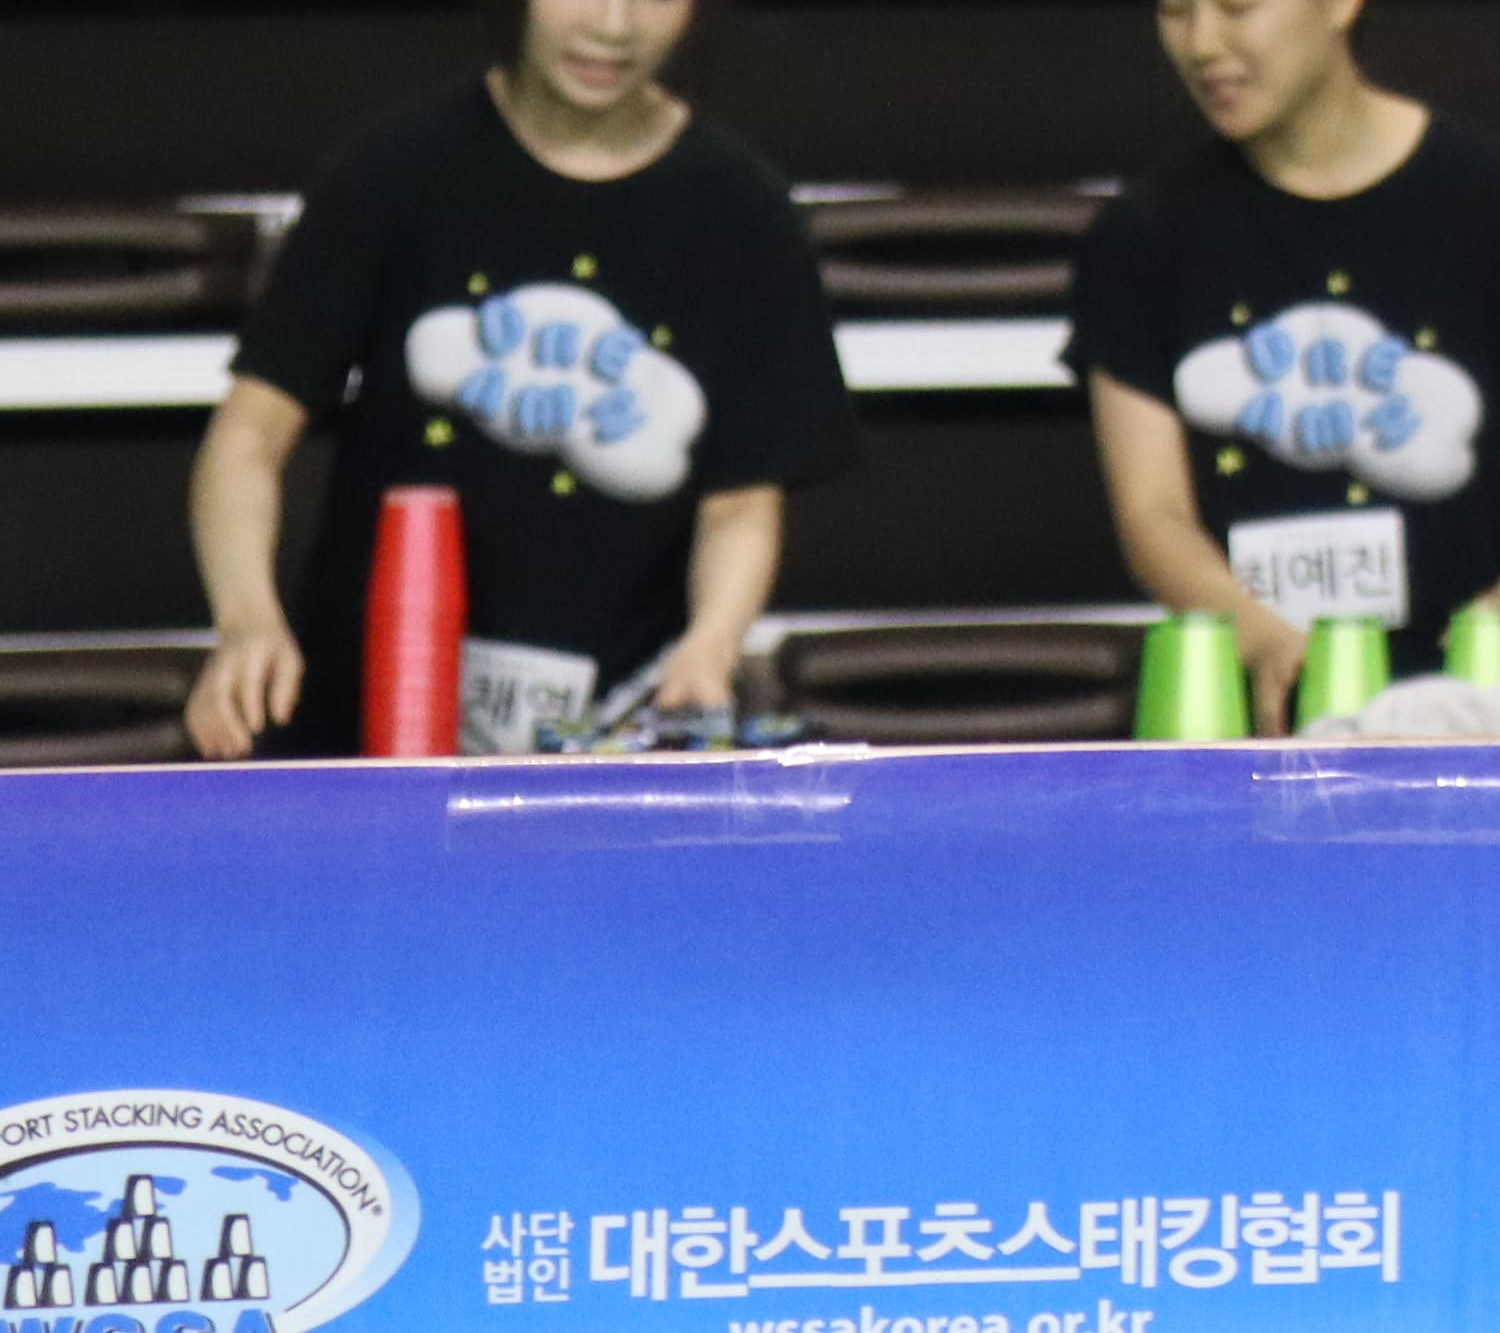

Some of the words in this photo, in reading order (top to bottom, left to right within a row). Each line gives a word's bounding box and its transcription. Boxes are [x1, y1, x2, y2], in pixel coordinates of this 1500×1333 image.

[63, 1103, 201, 1132] STACKING
[480, 1210, 575, 1257] 사단
[588, 1190, 1400, 1303] 대한스포츠스태킹협회
[482, 1255, 571, 1305] 법인
